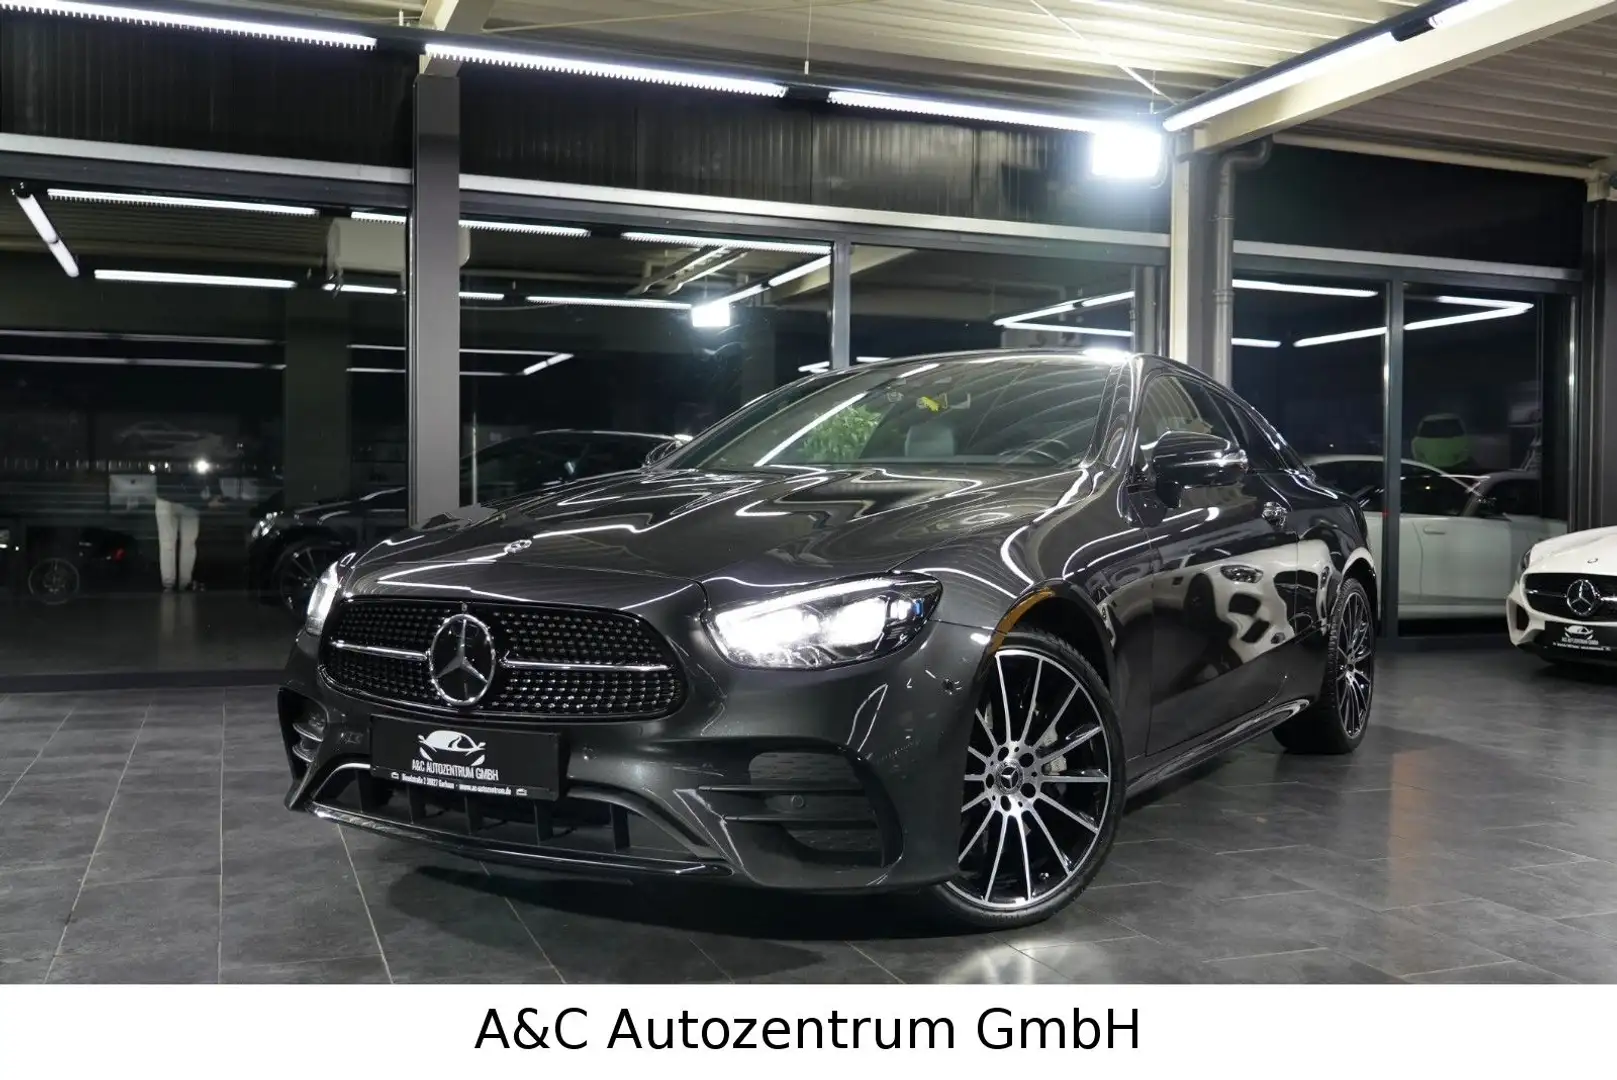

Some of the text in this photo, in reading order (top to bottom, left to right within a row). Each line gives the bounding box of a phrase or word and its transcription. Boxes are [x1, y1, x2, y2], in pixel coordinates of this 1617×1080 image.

[412, 759, 498, 780] A&C AUTOZENTRUM GMBH
